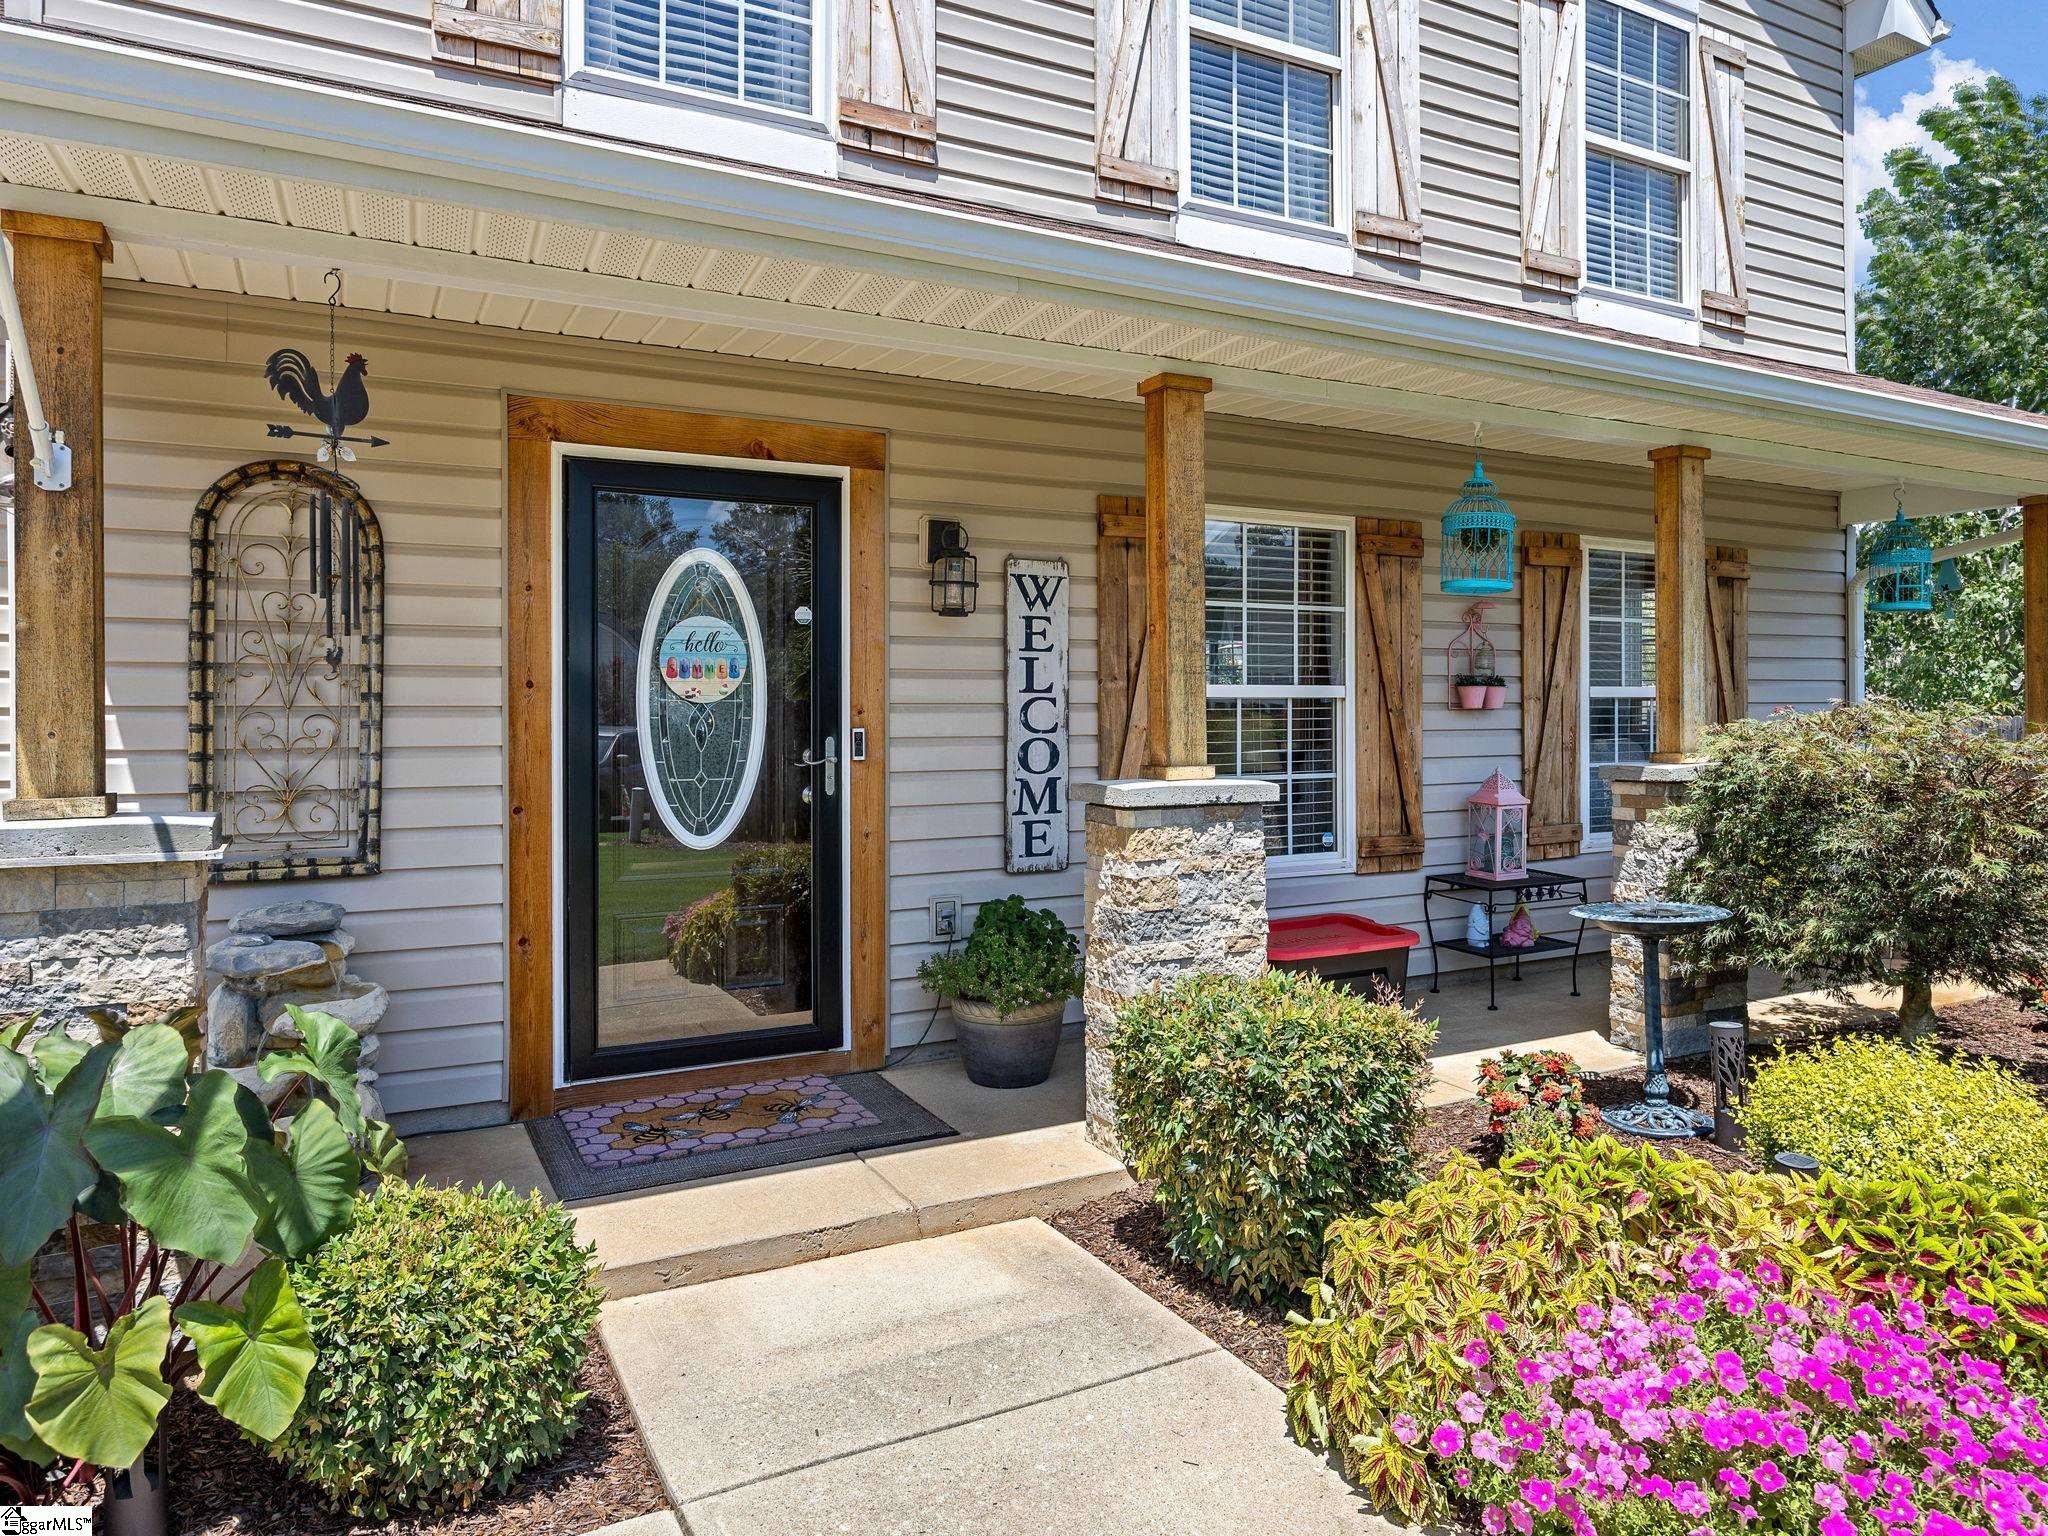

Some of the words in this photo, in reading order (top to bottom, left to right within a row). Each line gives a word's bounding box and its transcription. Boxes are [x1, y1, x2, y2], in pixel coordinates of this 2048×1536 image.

[673, 630, 736, 653] hello
[668, 662, 739, 675] SUMMER
[1009, 573, 1068, 858] WELCOME
